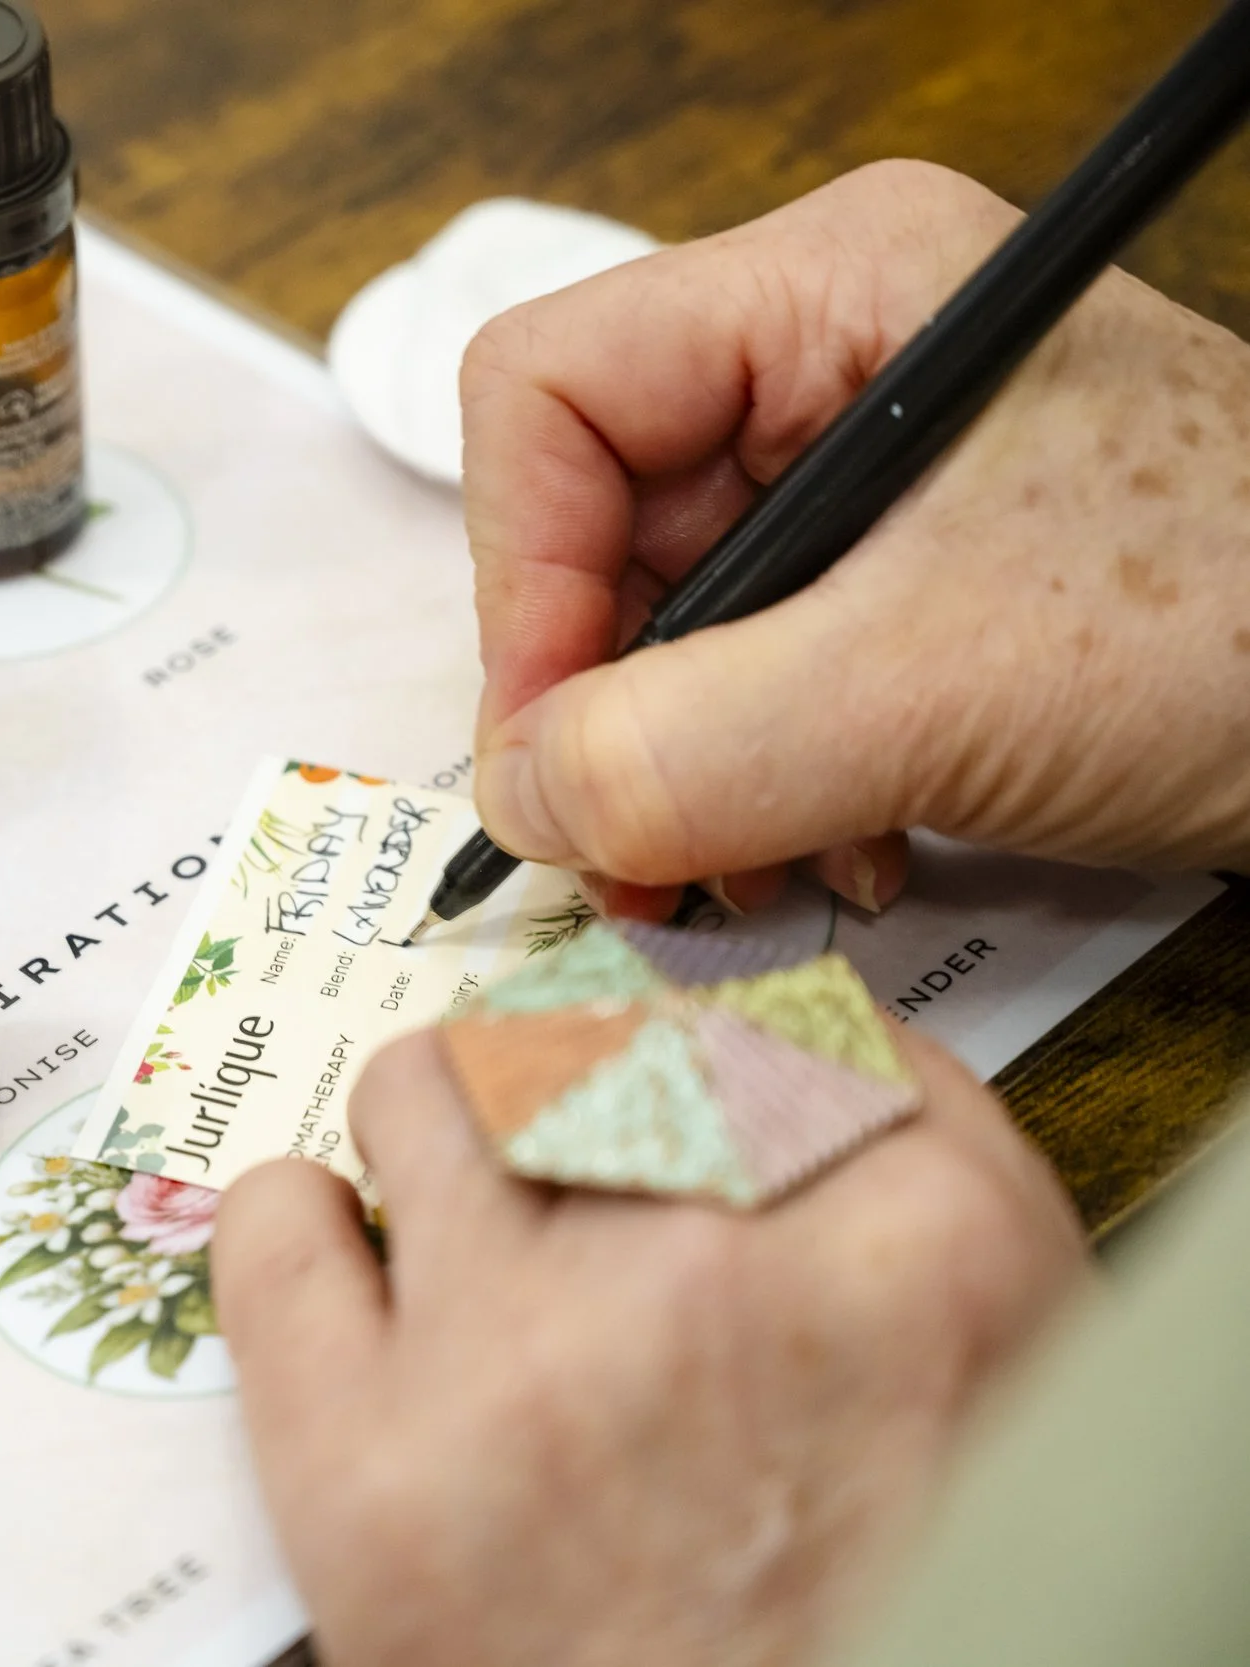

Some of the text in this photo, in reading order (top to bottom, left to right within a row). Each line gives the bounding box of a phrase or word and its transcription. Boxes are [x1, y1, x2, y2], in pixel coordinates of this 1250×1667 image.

[143, 624, 238, 689] ROSE
[264, 804, 369, 938] FRIDAY
[260, 936, 296, 985] Name:
[321, 951, 356, 998] Blend:
[381, 971, 413, 1011] Date:
[166, 1014, 278, 1173] Jurlique
[287, 1033, 355, 1159] OMATHERAPY
